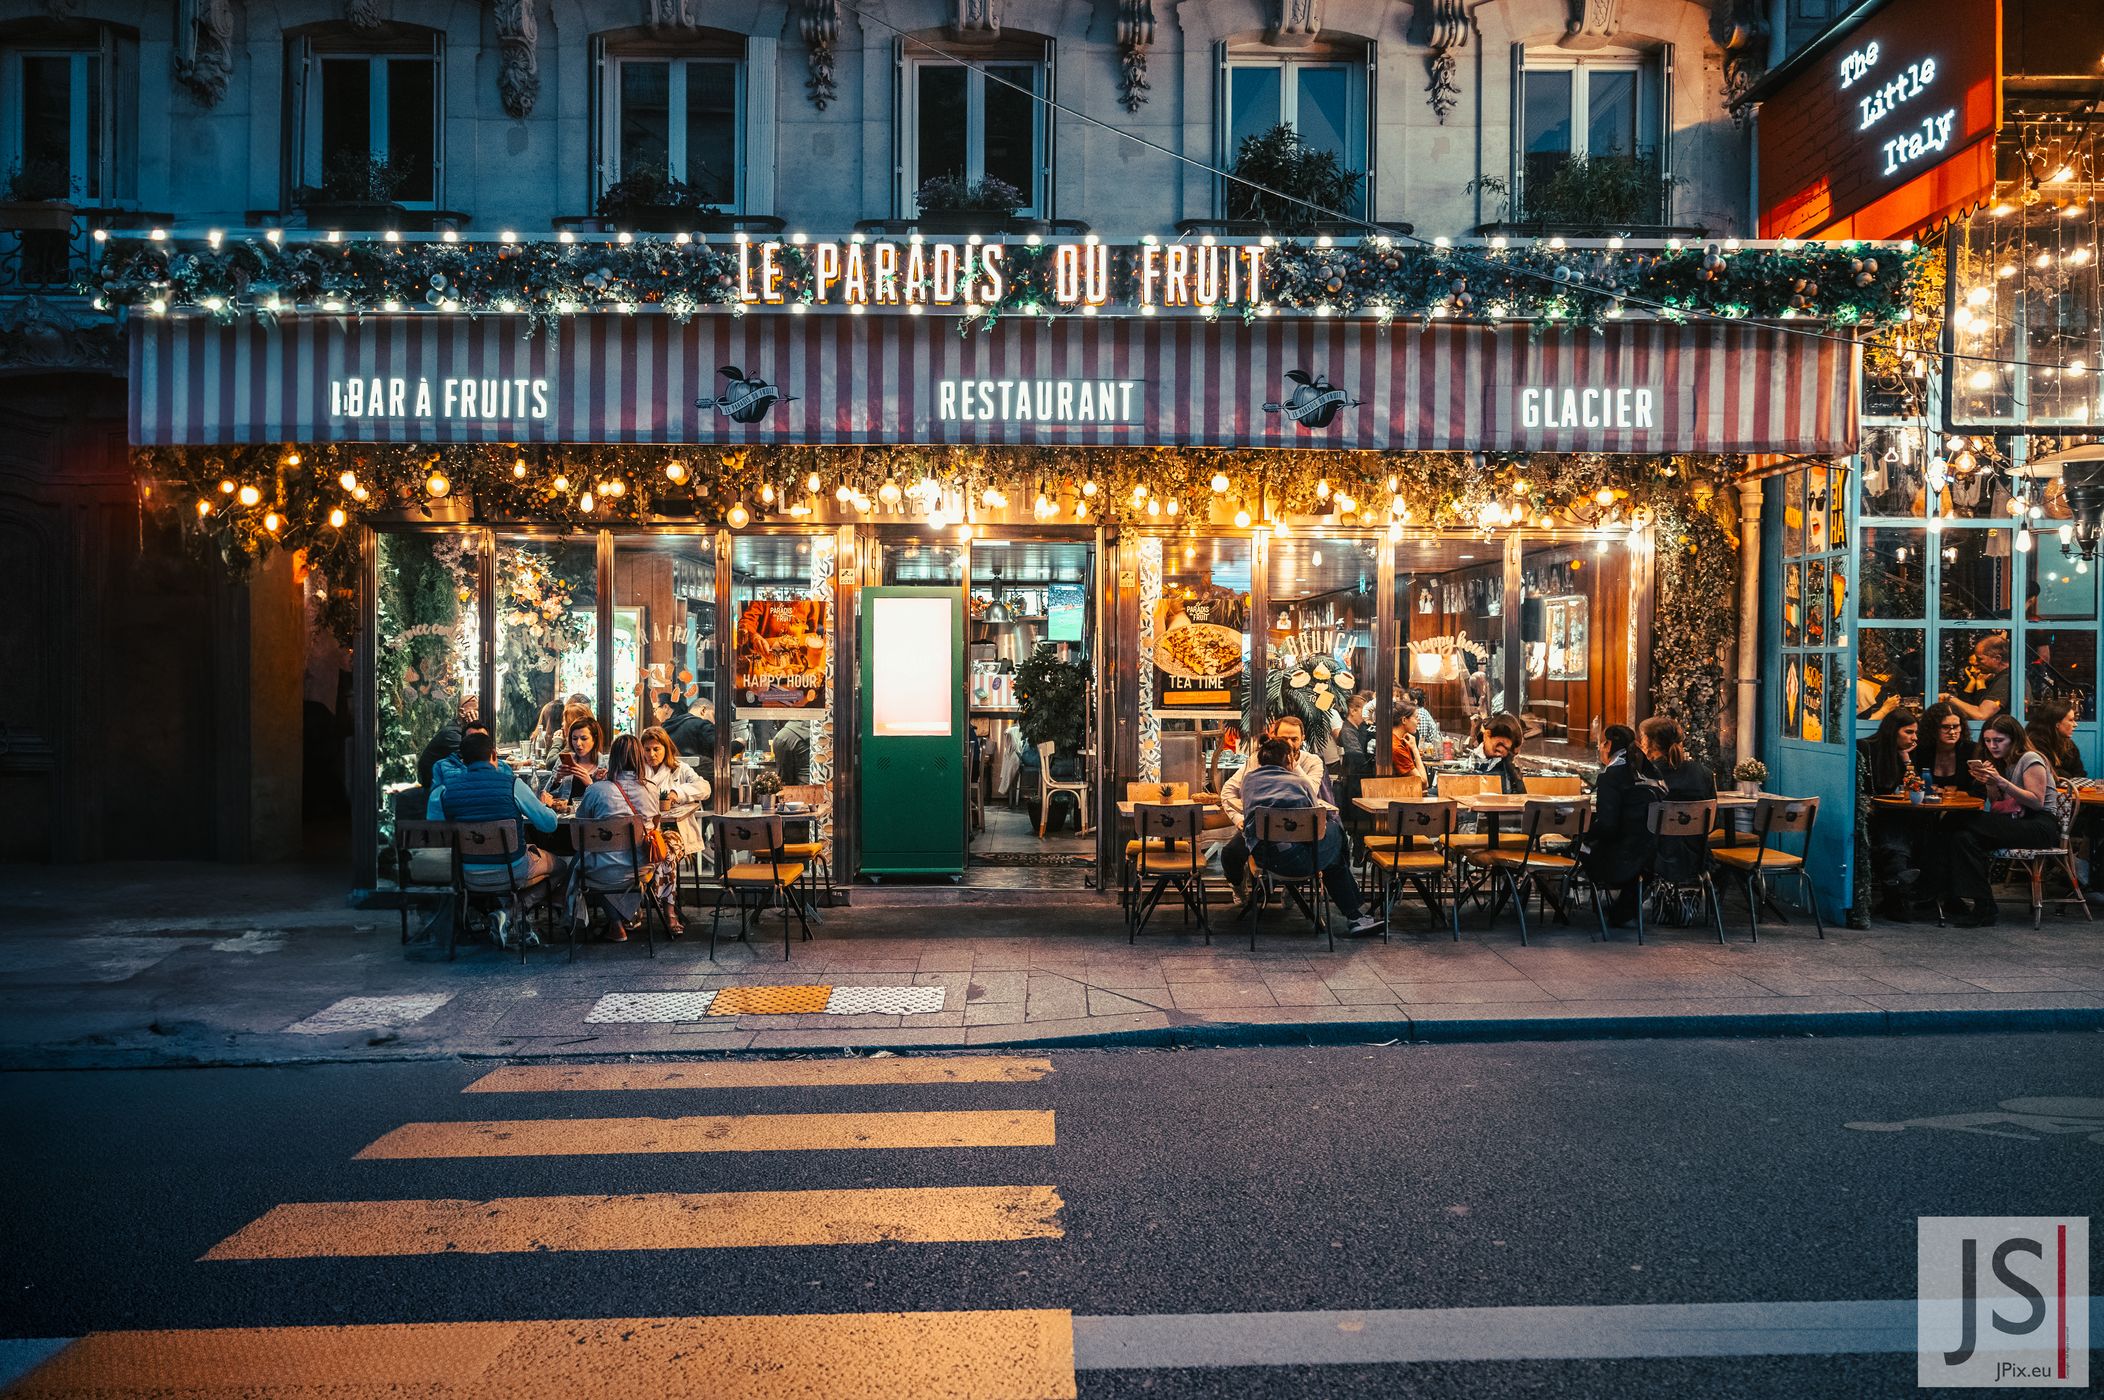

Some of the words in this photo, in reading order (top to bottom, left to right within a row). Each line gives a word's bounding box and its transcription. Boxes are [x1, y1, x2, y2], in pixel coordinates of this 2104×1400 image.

[1840, 41, 1880, 89] The
[1859, 58, 1937, 131] Little
[1883, 109, 1955, 177] Italy
[738, 240, 784, 302] LE
[816, 242, 1003, 304] PARADIS
[1057, 244, 1108, 304] DU
[1143, 244, 1268, 304] FRUIT
[347, 377, 405, 418] BAR
[414, 376, 432, 418] À
[444, 378, 549, 419] FRUITS
[939, 380, 1135, 421] RESTAURANT
[1521, 386, 1654, 429] GLACIER
[1285, 630, 1358, 658] BRUNCH
[1406, 635, 1459, 659] Happy
[743, 674, 785, 688] HAPPY
[786, 674, 817, 688] HOUR
[1169, 675, 1192, 689] TEA
[1198, 675, 1224, 689] TIME
